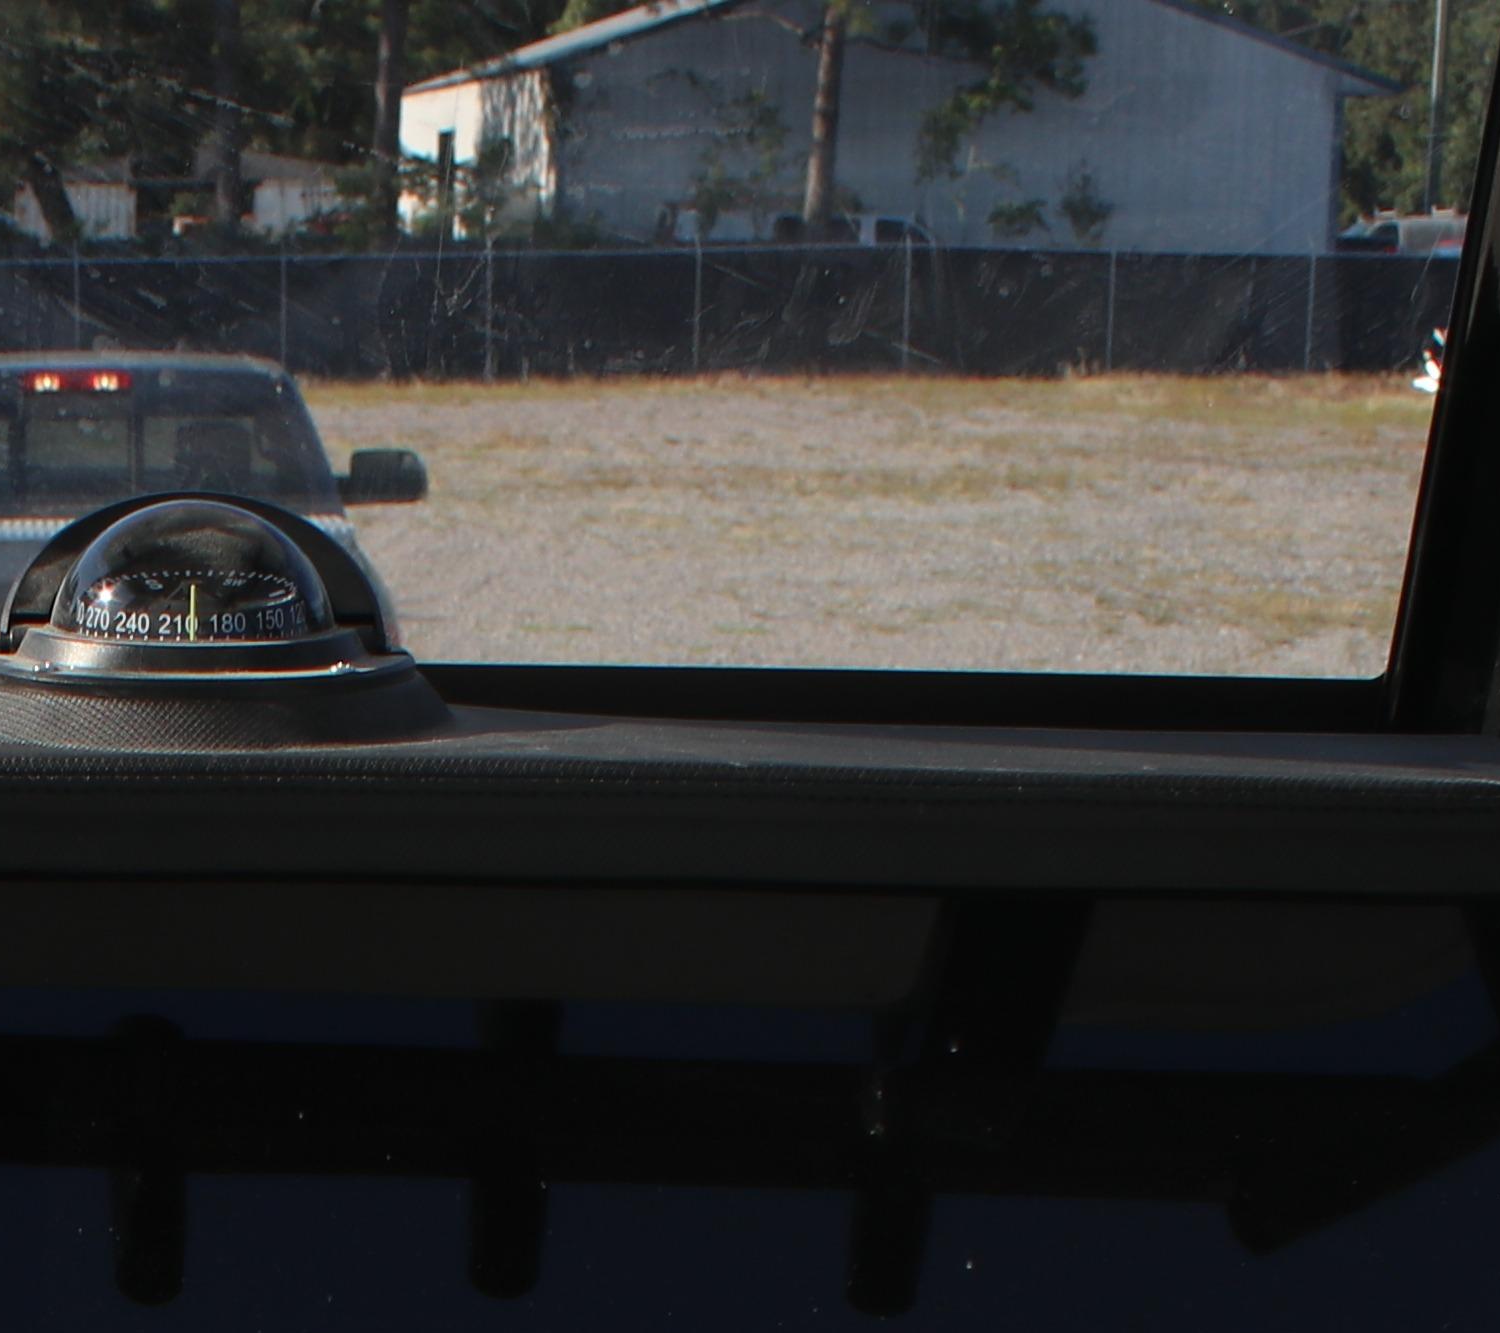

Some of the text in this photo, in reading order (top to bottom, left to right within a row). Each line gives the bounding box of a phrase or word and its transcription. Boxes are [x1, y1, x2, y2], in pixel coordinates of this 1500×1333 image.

[86, 606, 110, 631] 270
[115, 611, 150, 634] 240
[158, 613, 198, 634] 210
[210, 612, 246, 633] 180
[256, 608, 284, 630] 150
